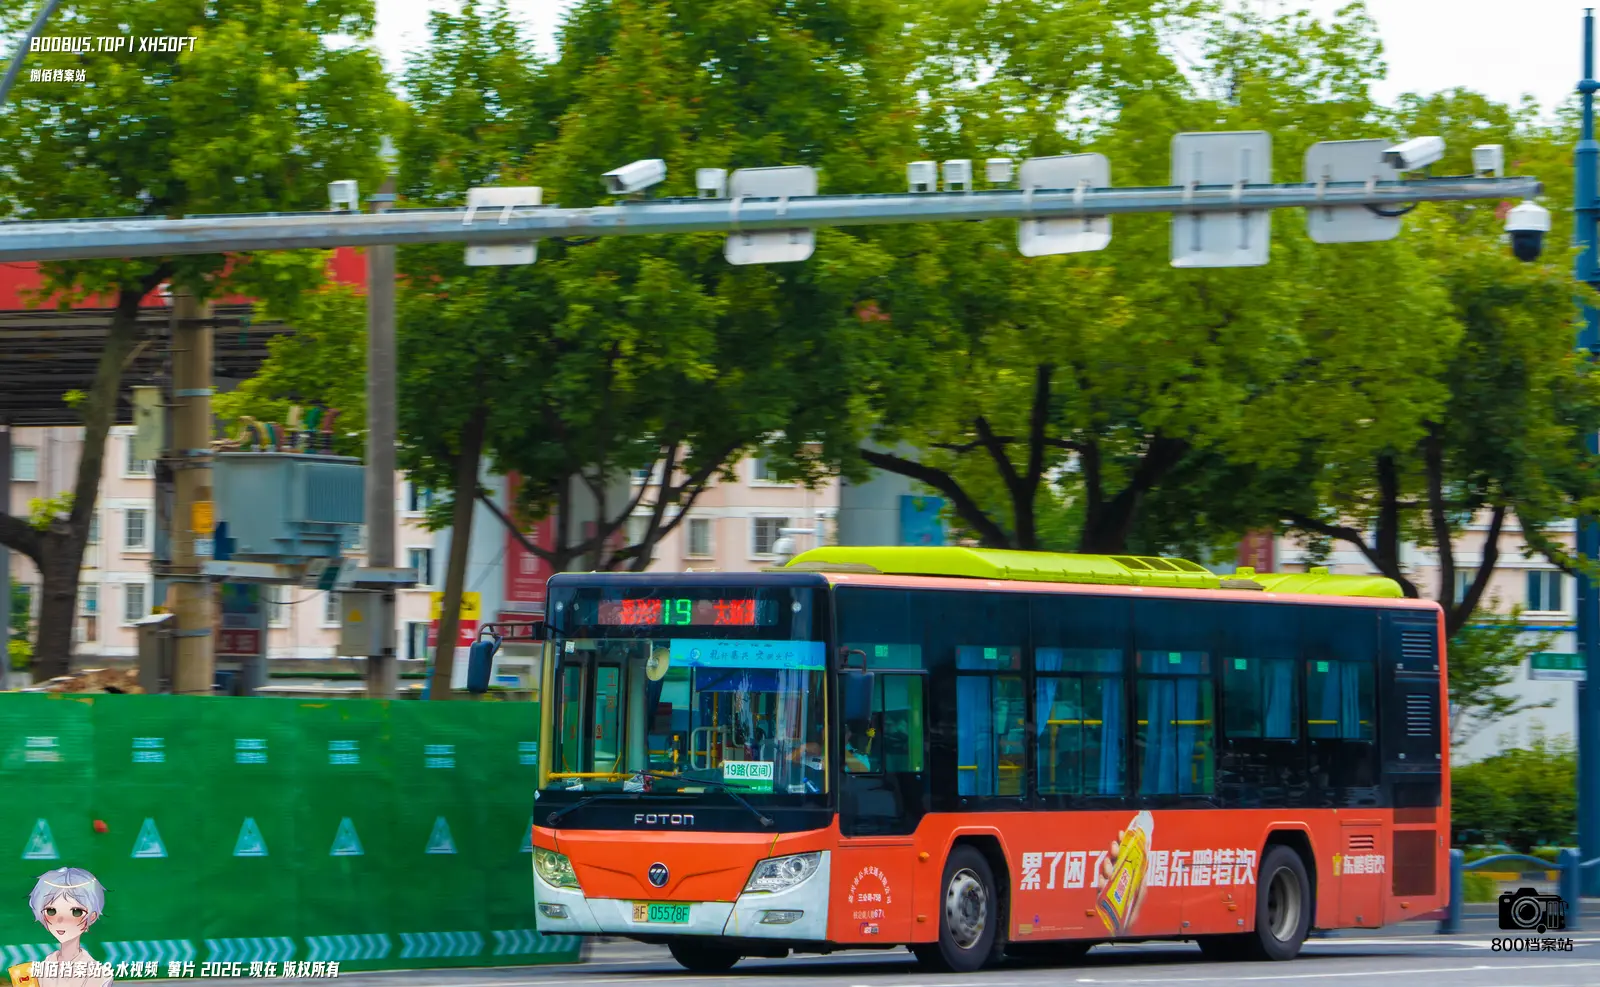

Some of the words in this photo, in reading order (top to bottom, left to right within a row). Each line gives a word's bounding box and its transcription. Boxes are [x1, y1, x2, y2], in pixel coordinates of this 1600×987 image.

[663, 598, 692, 626] 19
[725, 763, 772, 778] 19路(区间)
[634, 813, 695, 825] FOTON
[1019, 851, 1109, 890] 累了困了
[1146, 848, 1256, 888] 喝东鹏特饮
[650, 906, 689, 921] 05578F
